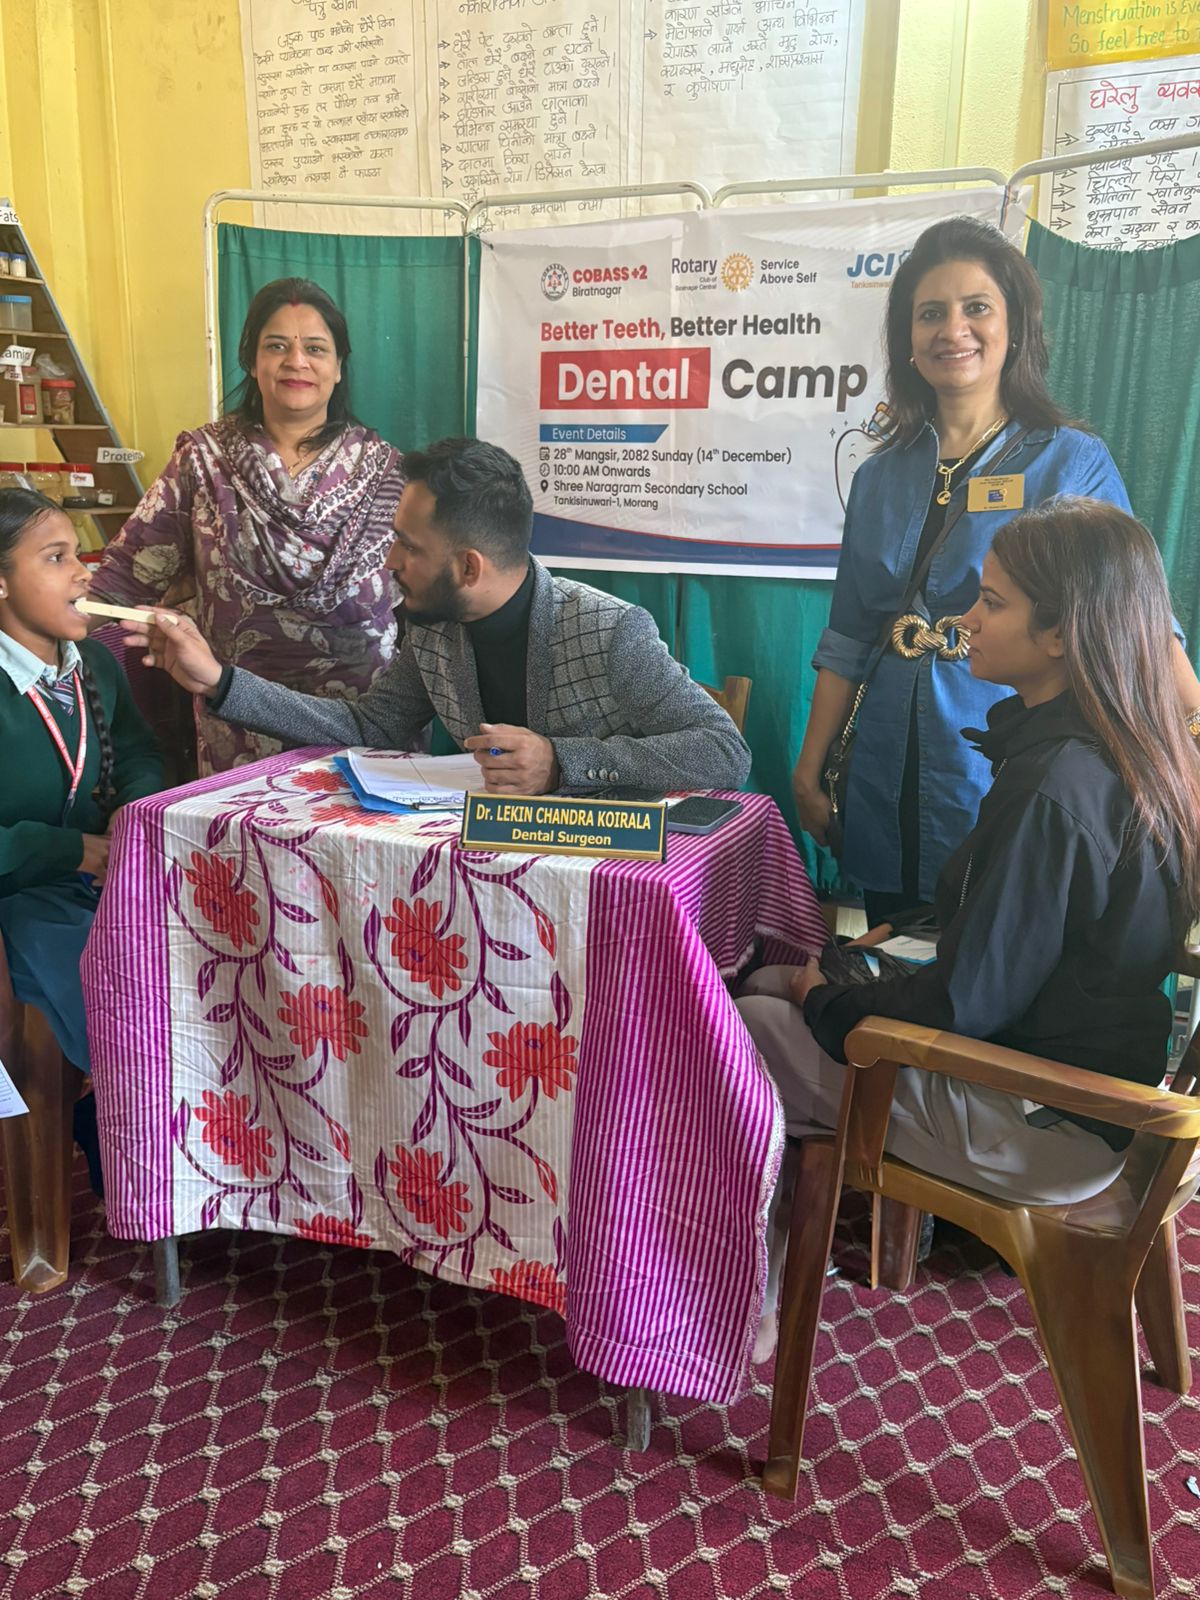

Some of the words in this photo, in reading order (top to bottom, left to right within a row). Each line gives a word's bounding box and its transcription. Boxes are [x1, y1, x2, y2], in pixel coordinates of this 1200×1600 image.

[1063, 0, 1161, 27] Menstruation
[1069, 33, 1089, 53] So
[1098, 28, 1128, 50] feel
[1136, 25, 1165, 46] free
[1174, 21, 1190, 41] to
[1167, 221, 1179, 233] र
[672, 258, 718, 276] Rotary
[760, 259, 800, 271] Service
[847, 253, 895, 277] JCI
[573, 266, 630, 284] COBASS
[631, 265, 648, 280] +2
[760, 274, 795, 285] Above
[796, 272, 818, 284] Self
[572, 286, 622, 298] Biratnagar
[541, 321, 598, 341] Better
[603, 317, 666, 341] Teeth,
[670, 316, 738, 337] Better
[742, 312, 821, 336] Health
[558, 357, 690, 401] Dental
[721, 358, 869, 413] Camp
[552, 428, 584, 440] Event
[587, 427, 627, 440] Details
[575, 448, 620, 464] Mangsir,
[622, 449, 649, 461] 2082
[651, 449, 693, 465] Sunday
[722, 446, 792, 465] December)
[553, 464, 580, 476] 10:00
[583, 465, 599, 477] AM
[602, 465, 651, 477] Onwards
[553, 480, 584, 492] Shree
[586, 481, 642, 496] Naragram
[644, 482, 704, 498] Secondary
[707, 483, 748, 495] School
[624, 498, 658, 511] Morang
[476, 804, 493, 821] Dr.
[497, 805, 533, 824] LEKIN
[536, 808, 594, 827] CHANDRA
[597, 811, 651, 830] KOIRALA
[511, 828, 554, 842] Dental
[557, 830, 612, 847] Surgeon
